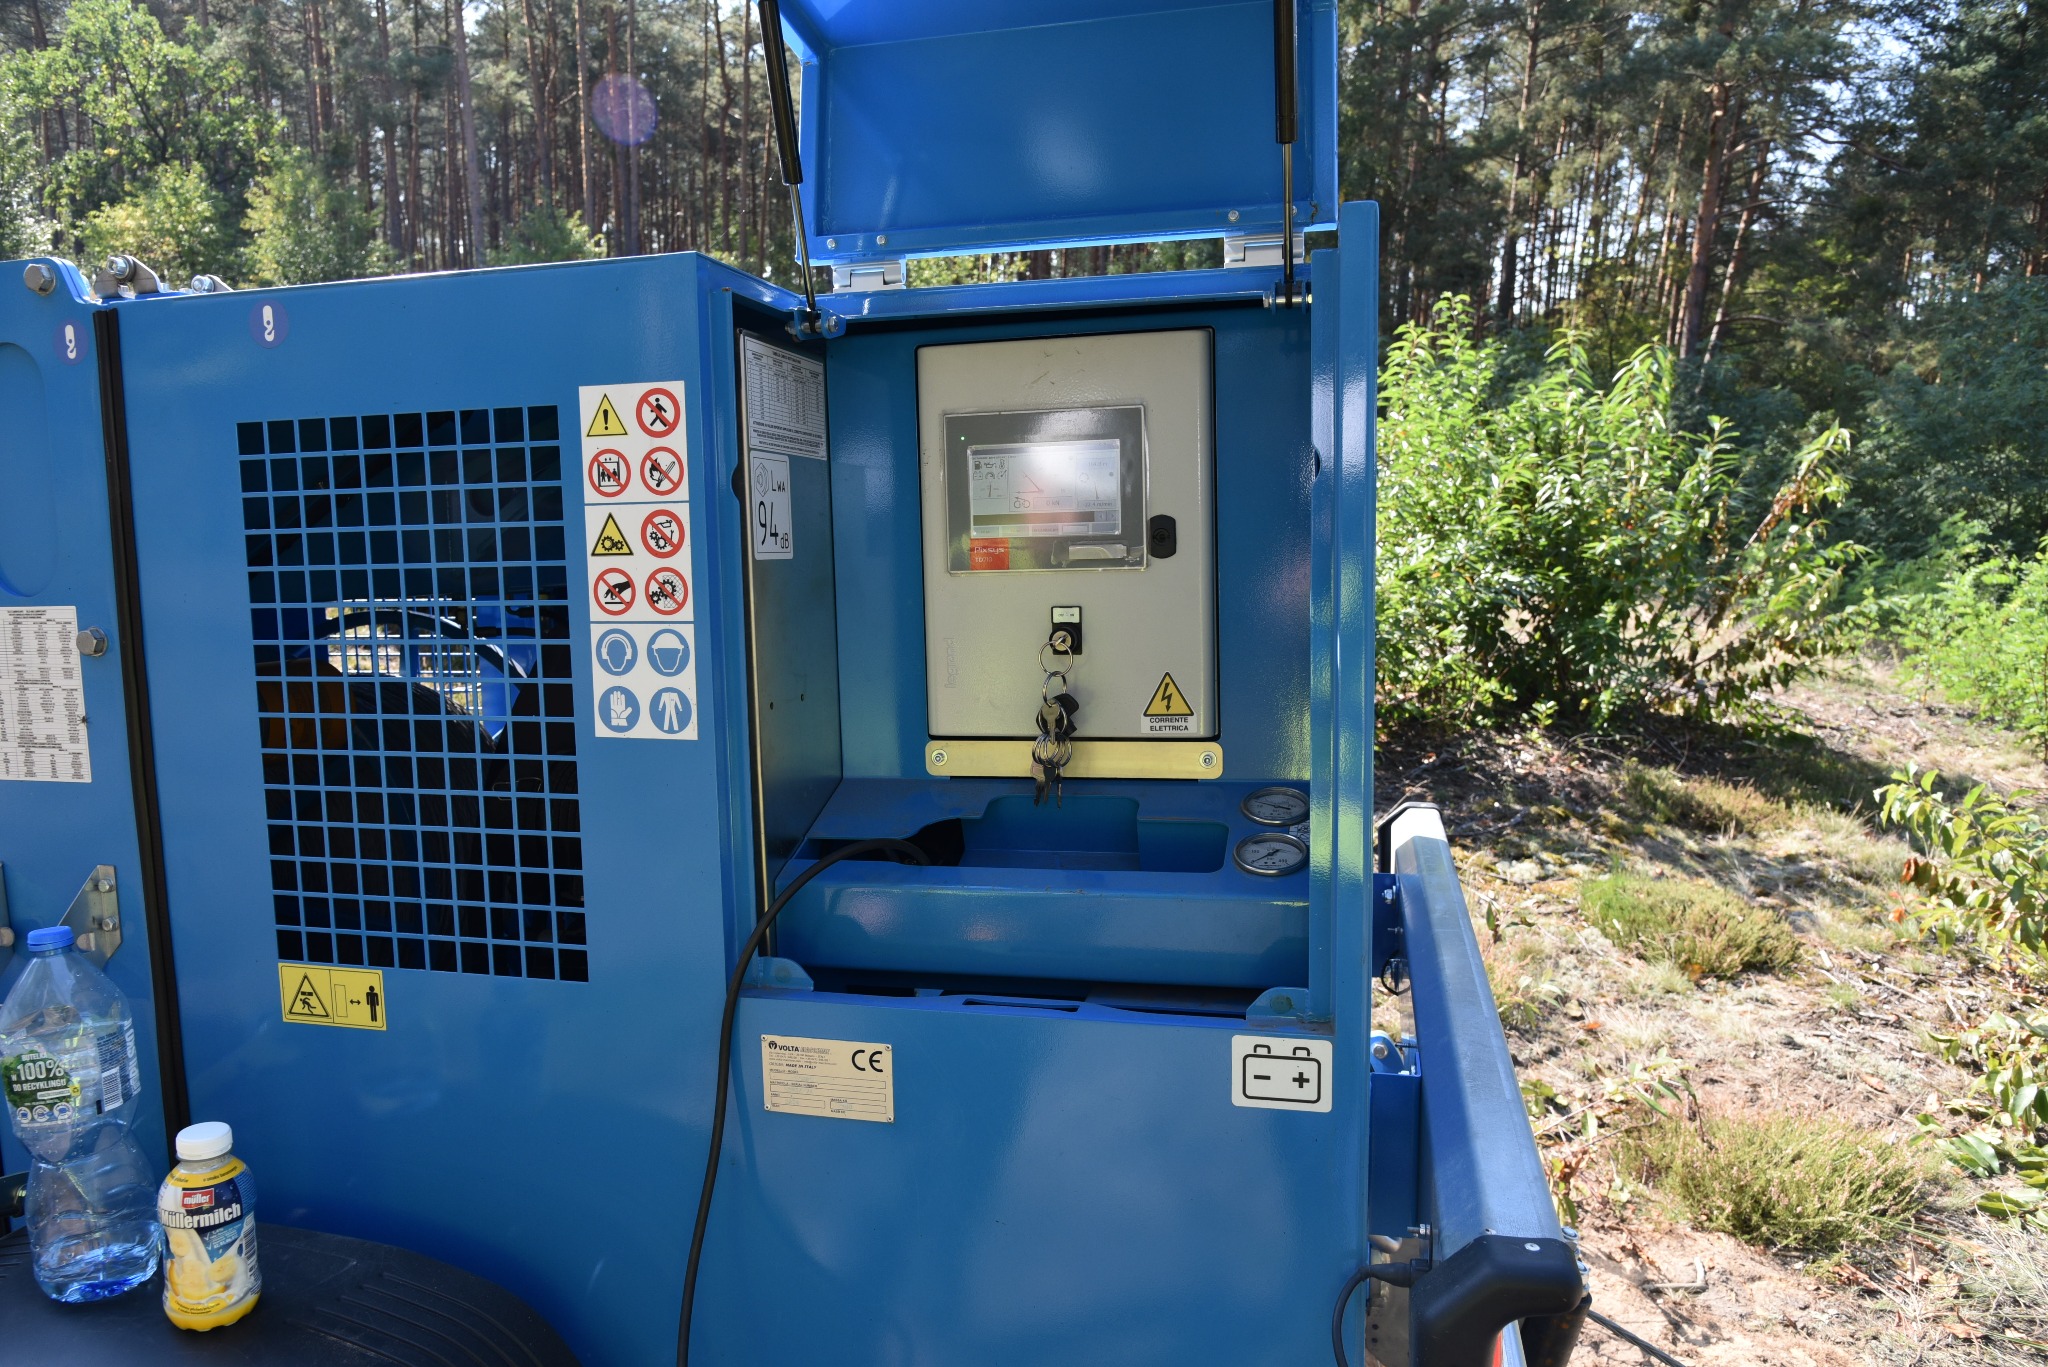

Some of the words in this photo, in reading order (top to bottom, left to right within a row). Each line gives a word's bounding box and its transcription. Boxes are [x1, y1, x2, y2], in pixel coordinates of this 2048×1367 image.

[758, 500, 779, 546] 94
[780, 532, 790, 550] dB
[974, 546, 1005, 555] Pixsys
[1149, 716, 1189, 724] CORRENTE
[1149, 724, 1189, 732] ELETTRICA
[778, 1044, 800, 1052] VOLTA
[21, 1052, 48, 1061] BUTELKA
[851, 1049, 884, 1073] CE
[17, 1060, 65, 1081] 100%
[12, 1084, 22, 1092] DO
[22, 1079, 67, 1091] RECYKLINGU
[183, 1194, 210, 1205] müller
[161, 1203, 242, 1229] Müllermilch
